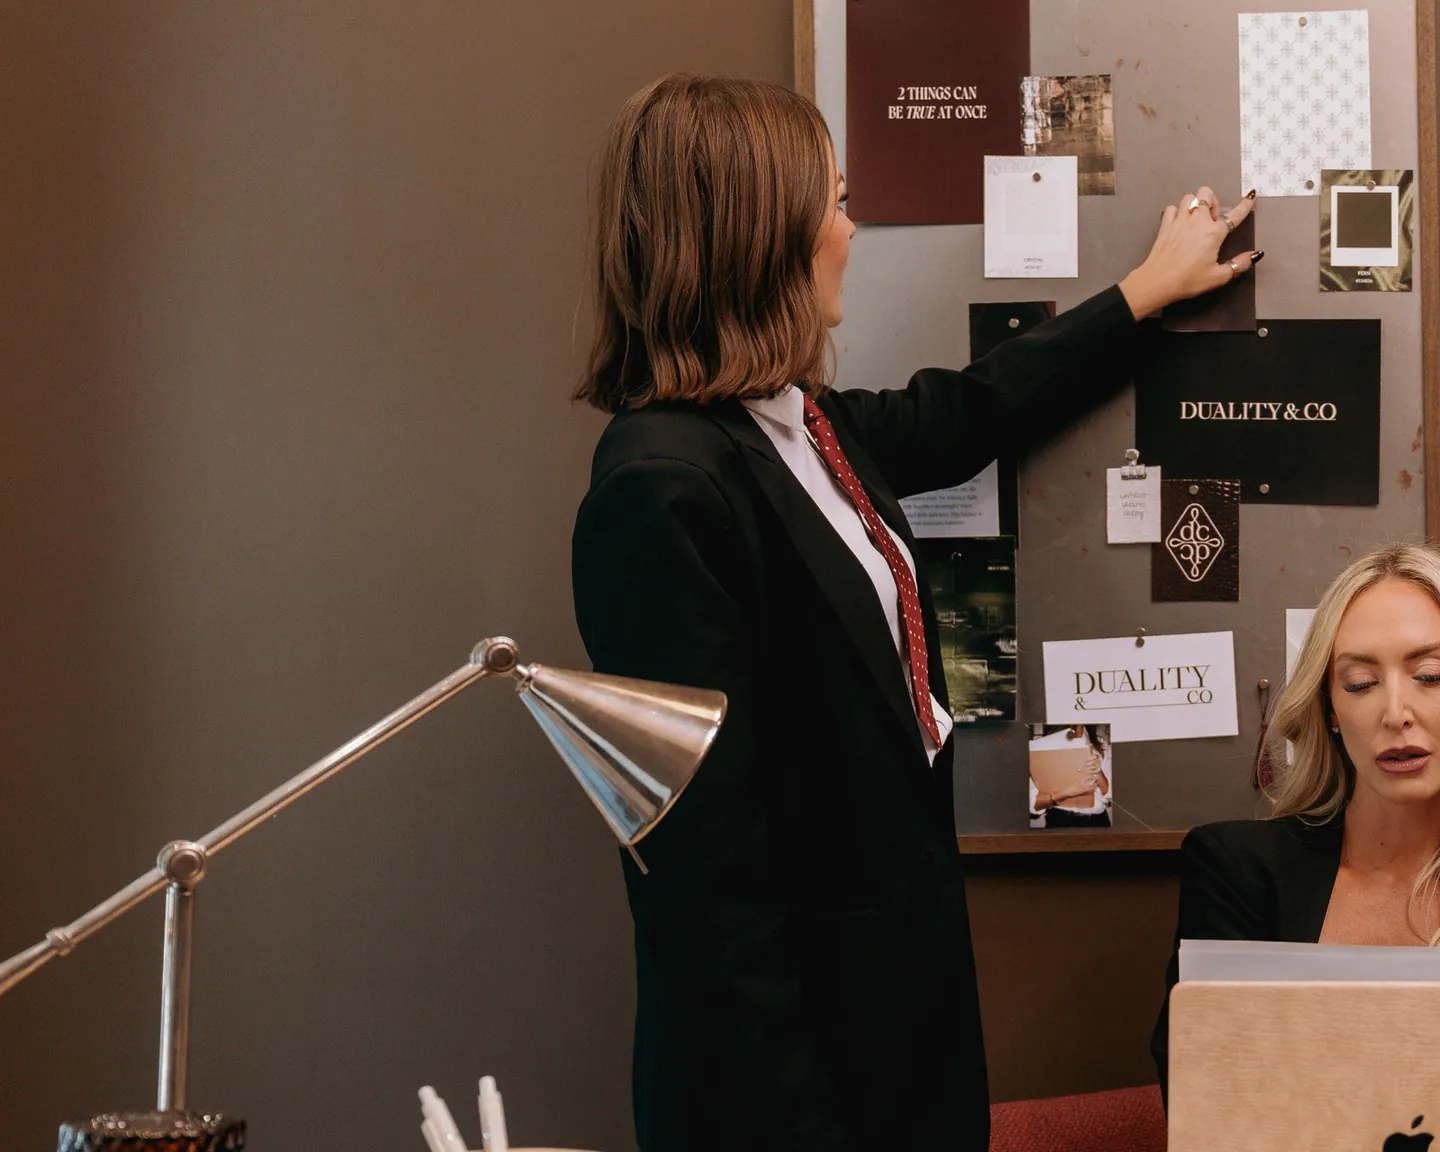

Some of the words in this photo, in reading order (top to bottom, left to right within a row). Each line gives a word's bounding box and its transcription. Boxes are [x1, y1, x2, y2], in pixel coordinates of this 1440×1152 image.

[897, 87, 905, 100] 2
[907, 86, 951, 100] THINGS
[953, 86, 977, 100] CAN
[888, 105, 903, 119] BE
[907, 105, 936, 119] TRUE
[937, 105, 953, 119] AT
[955, 105, 987, 119] ONCE
[1180, 402, 1282, 420] DUALITY
[1284, 402, 1300, 421] &
[1303, 402, 1337, 421] CO
[1074, 665, 1211, 695] DUALITY
[1074, 696, 1087, 711] &
[1187, 689, 1213, 705] CO
